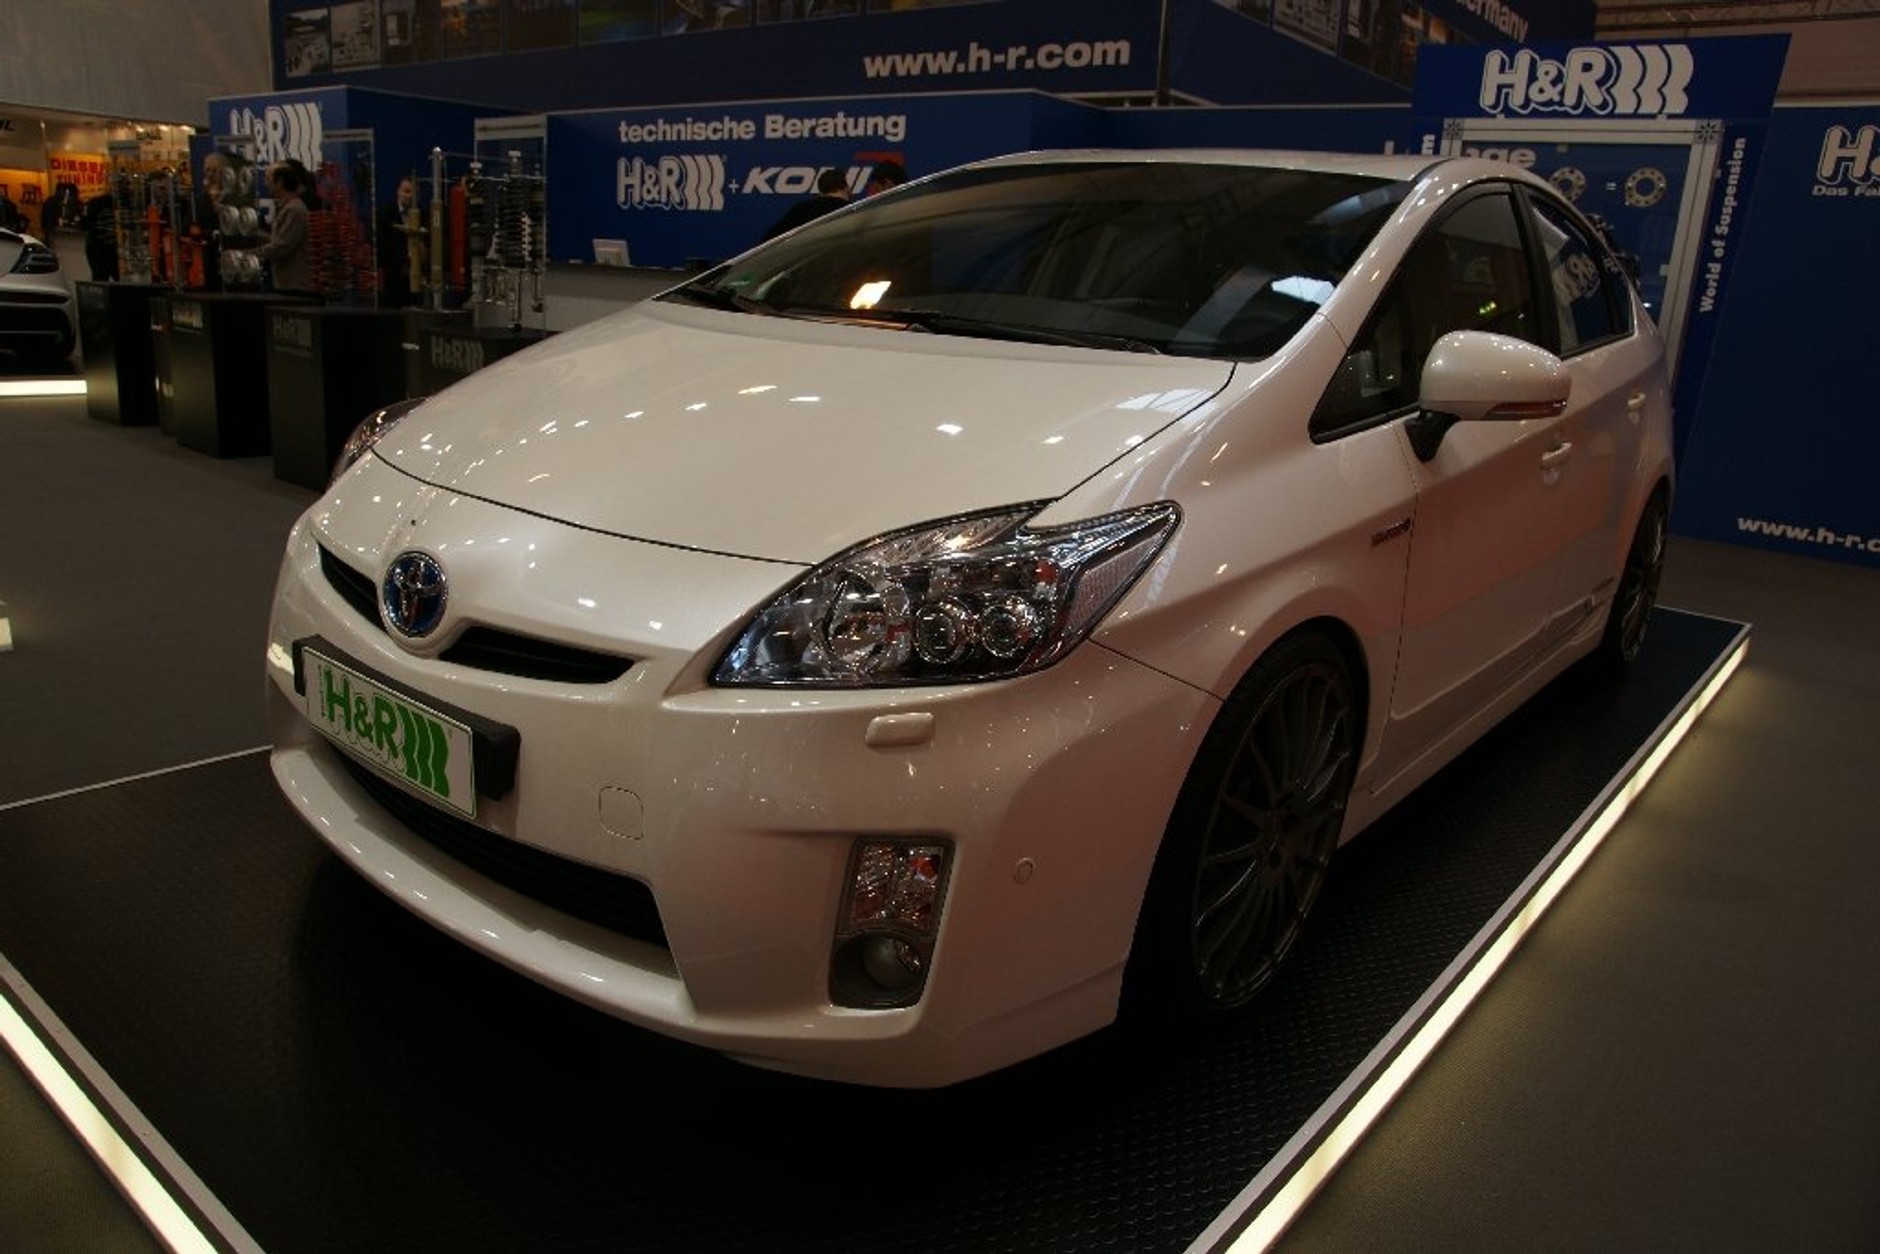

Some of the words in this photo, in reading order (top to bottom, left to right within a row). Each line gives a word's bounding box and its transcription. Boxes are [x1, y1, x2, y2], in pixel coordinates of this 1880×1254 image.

[863, 39, 1131, 78] www.h-r.com
[1479, 47, 1617, 114] H&R
[619, 115, 755, 143] technische
[764, 111, 906, 142] Beratung
[616, 156, 686, 210] H&R
[1714, 137, 1747, 236] Suspension
[1811, 185, 1849, 196] Das
[1711, 239, 1726, 258] of
[1698, 262, 1722, 313] World
[322, 665, 400, 762] H&R
